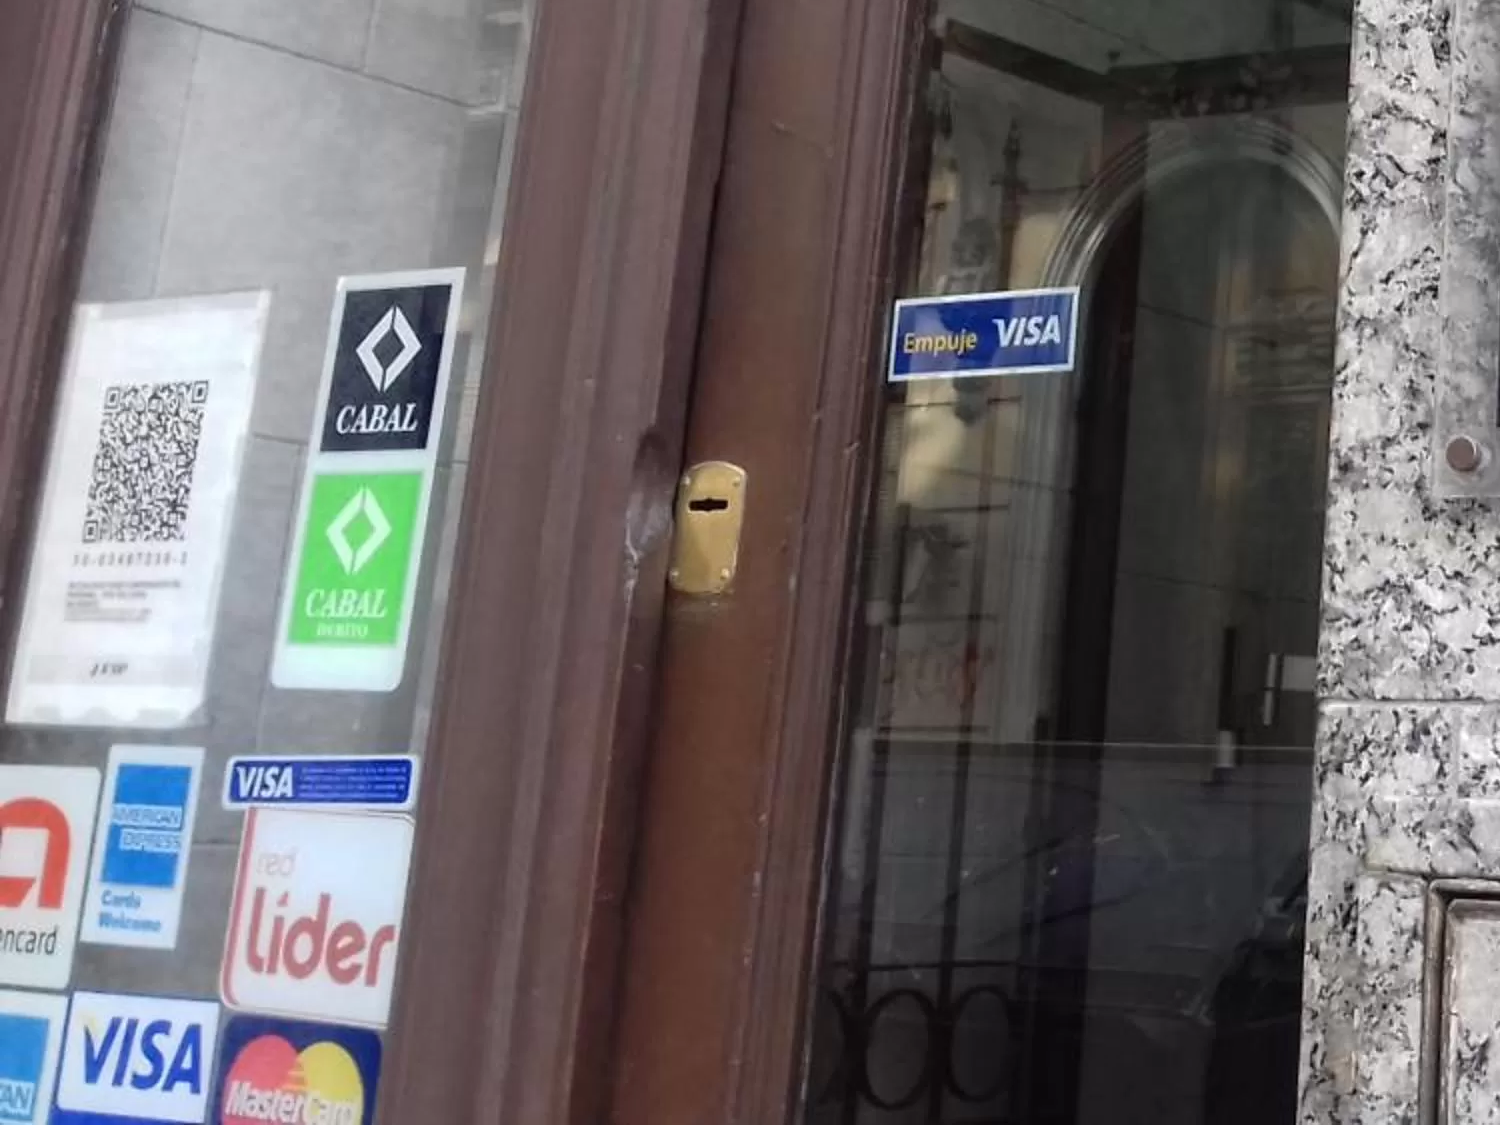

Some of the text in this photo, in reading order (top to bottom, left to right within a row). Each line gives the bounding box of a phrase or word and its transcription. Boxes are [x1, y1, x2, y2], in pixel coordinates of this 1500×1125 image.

[904, 314, 1062, 357] Empuje VISA
[336, 403, 419, 435] CABAL
[306, 588, 388, 618] CABAL
[236, 765, 294, 799] VISA
[83, 1016, 203, 1096] VISA
